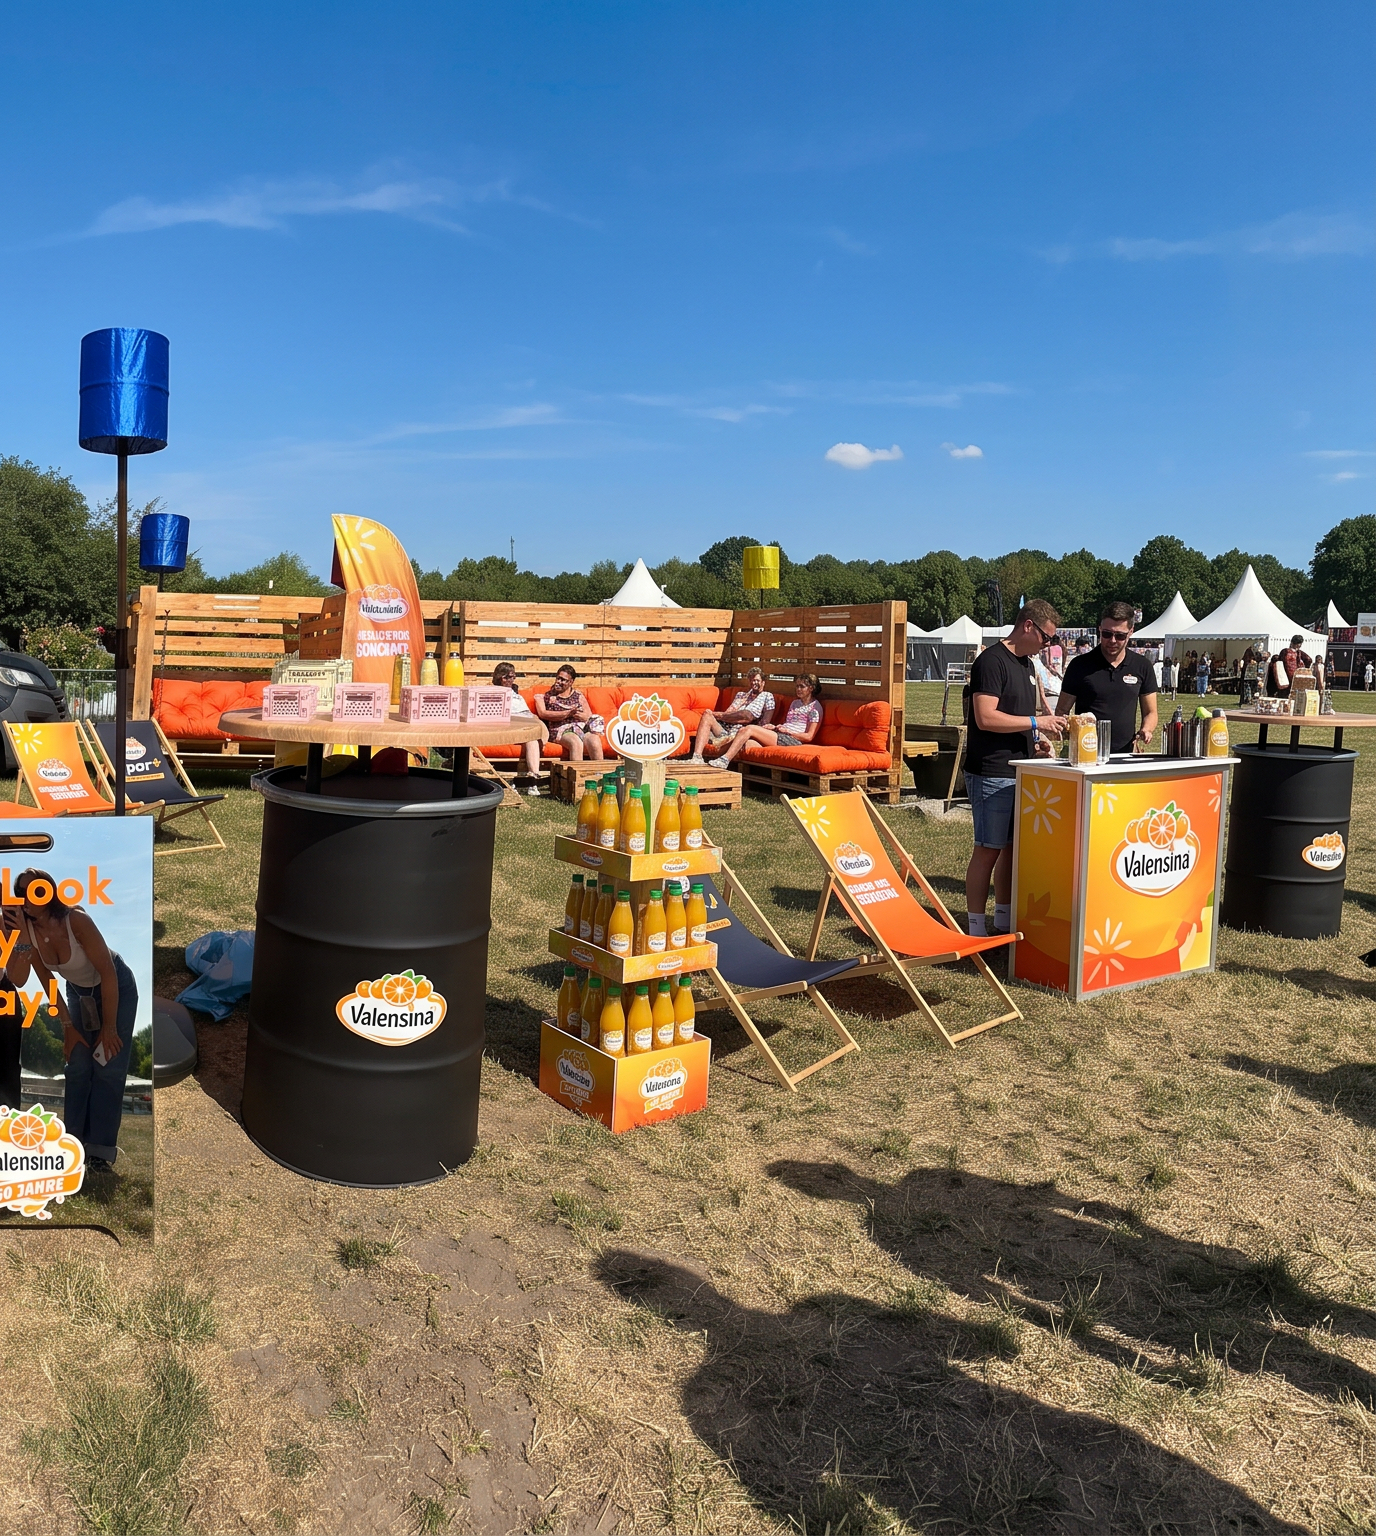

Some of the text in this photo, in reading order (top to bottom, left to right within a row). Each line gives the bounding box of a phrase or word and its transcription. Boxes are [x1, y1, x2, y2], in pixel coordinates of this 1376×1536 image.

[617, 725, 676, 745] Valensina
[1124, 850, 1190, 879] Valensina
[1, 865, 115, 906] Look
[350, 1003, 434, 1028] Valensina
[16, 1177, 65, 1198] JAHRE
